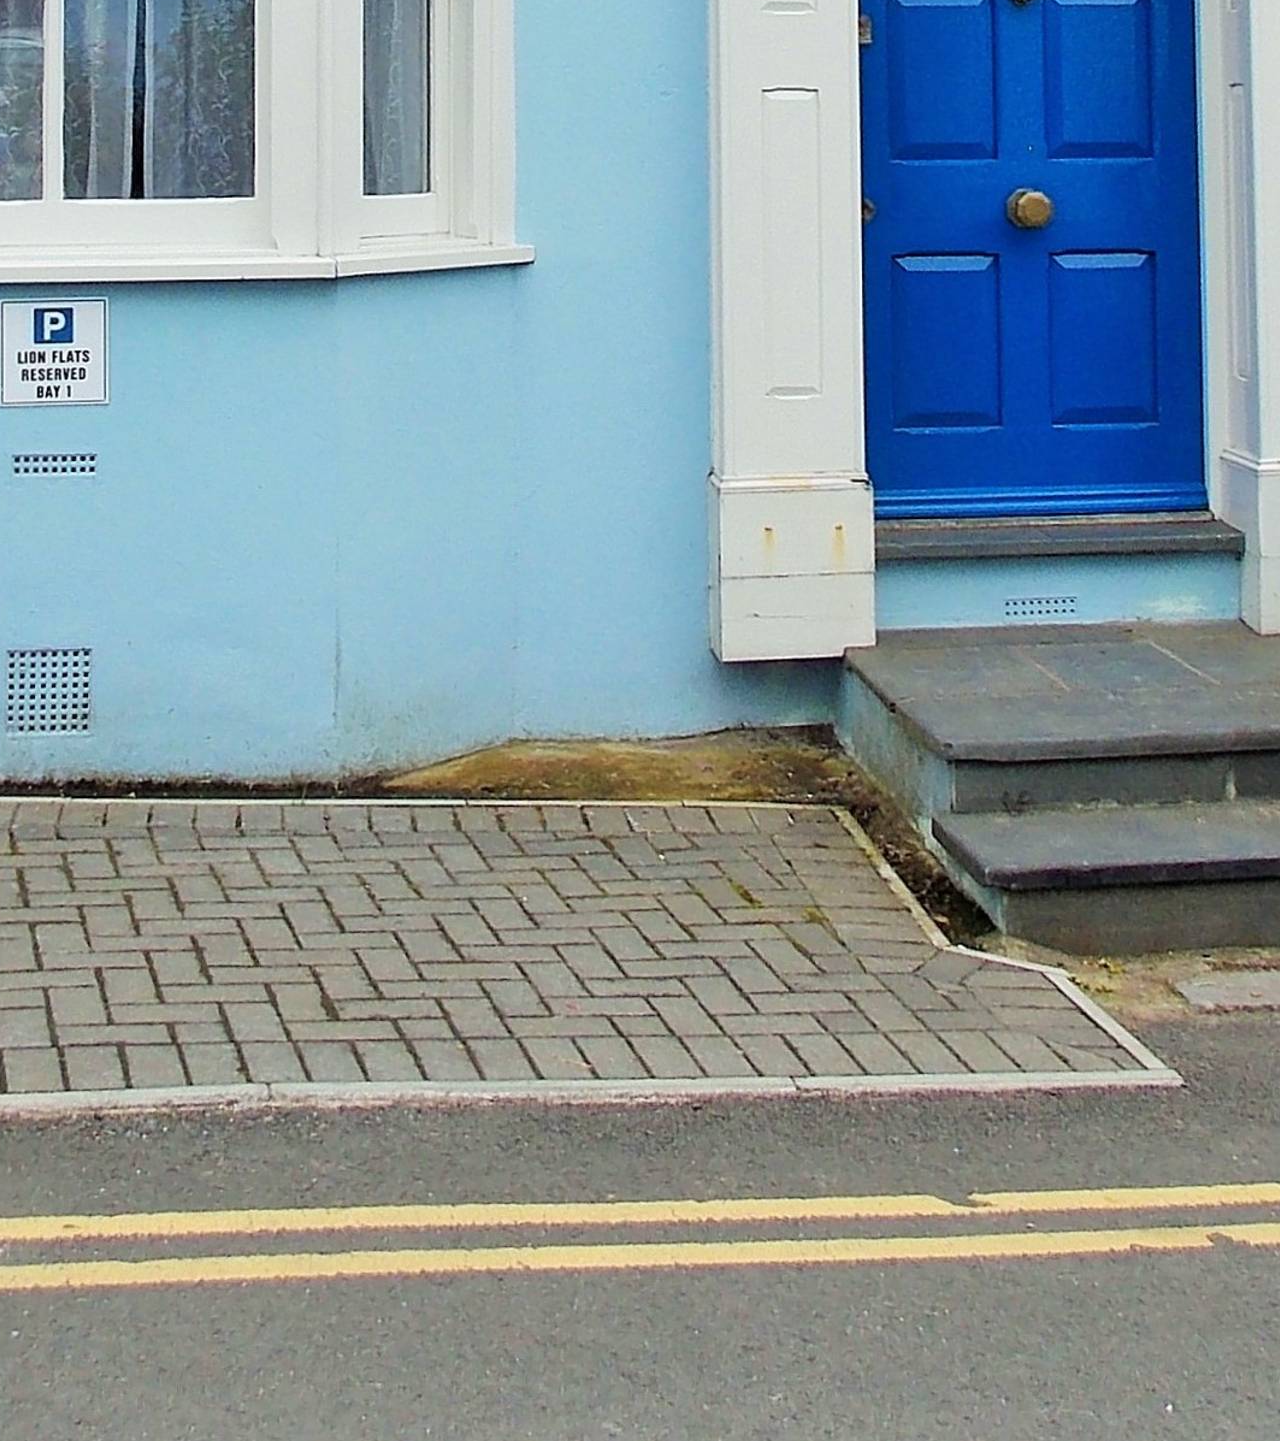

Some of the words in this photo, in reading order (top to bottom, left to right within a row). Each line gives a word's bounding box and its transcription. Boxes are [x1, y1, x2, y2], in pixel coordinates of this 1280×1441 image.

[43, 311, 66, 341] P
[17, 351, 46, 364] LION
[52, 350, 90, 363] FLATS
[21, 367, 86, 381] RESERVED
[36, 385, 60, 398] BAY
[66, 385, 71, 398] 1
